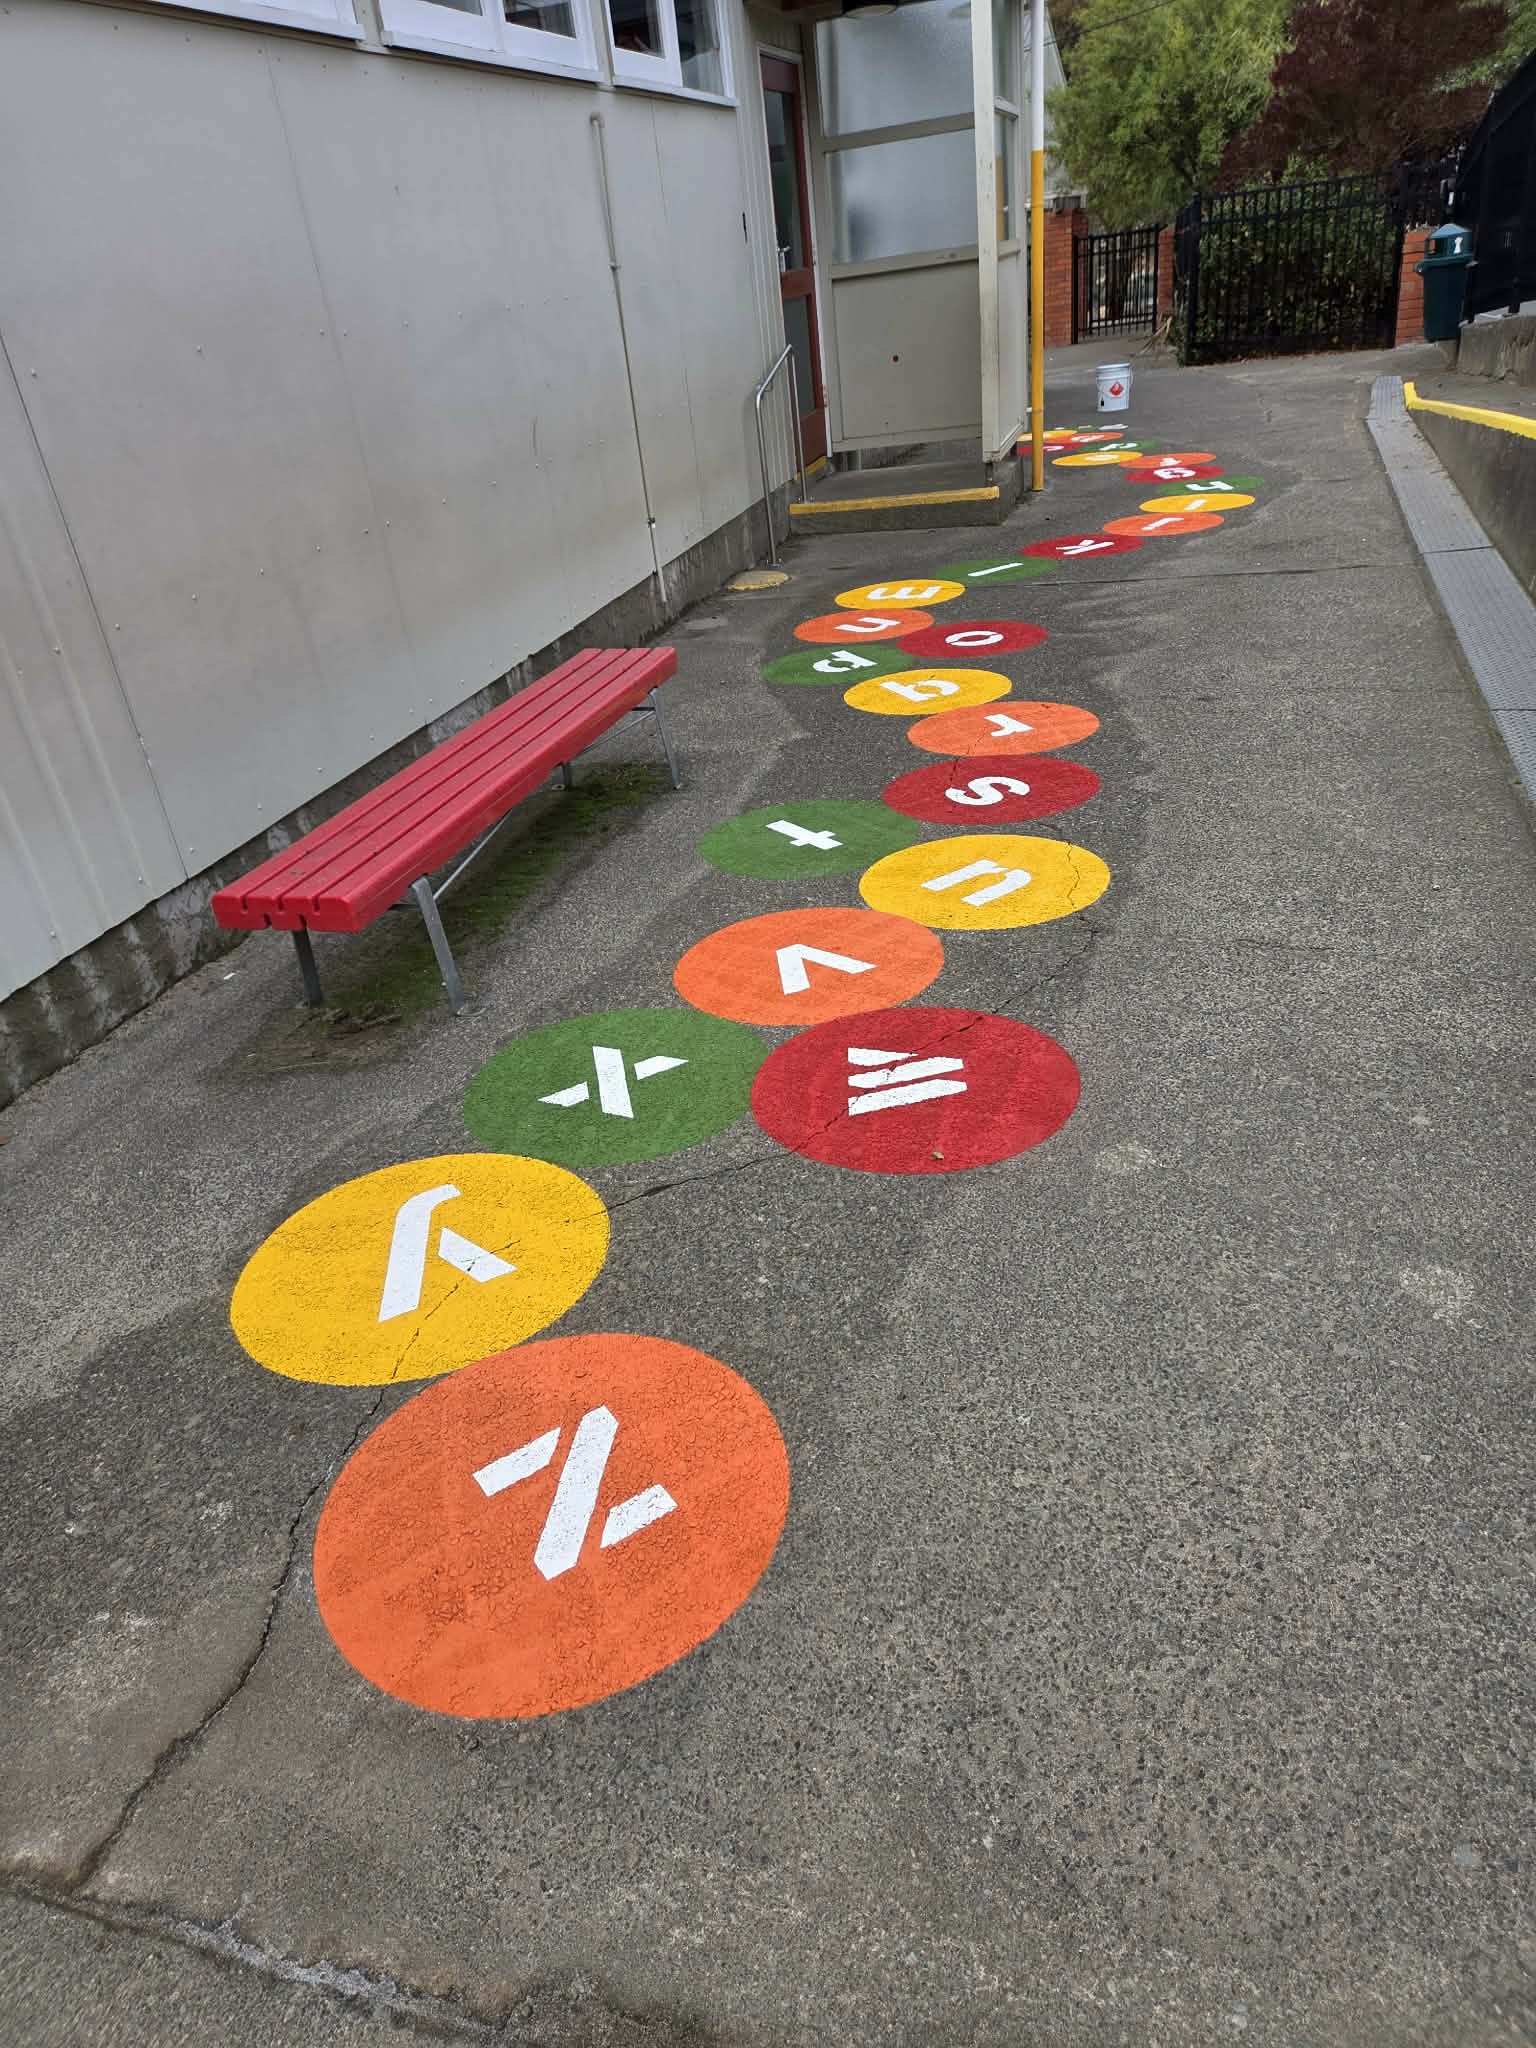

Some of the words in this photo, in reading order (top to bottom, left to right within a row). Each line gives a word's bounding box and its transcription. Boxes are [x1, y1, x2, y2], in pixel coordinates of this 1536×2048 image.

[946, 631, 1003, 646] o
[984, 714, 1034, 736] r
[945, 777, 1030, 805] s
[766, 820, 842, 850] t
[538, 1046, 688, 1118] x
[379, 1184, 516, 1322] y
[473, 1405, 677, 1580] z
